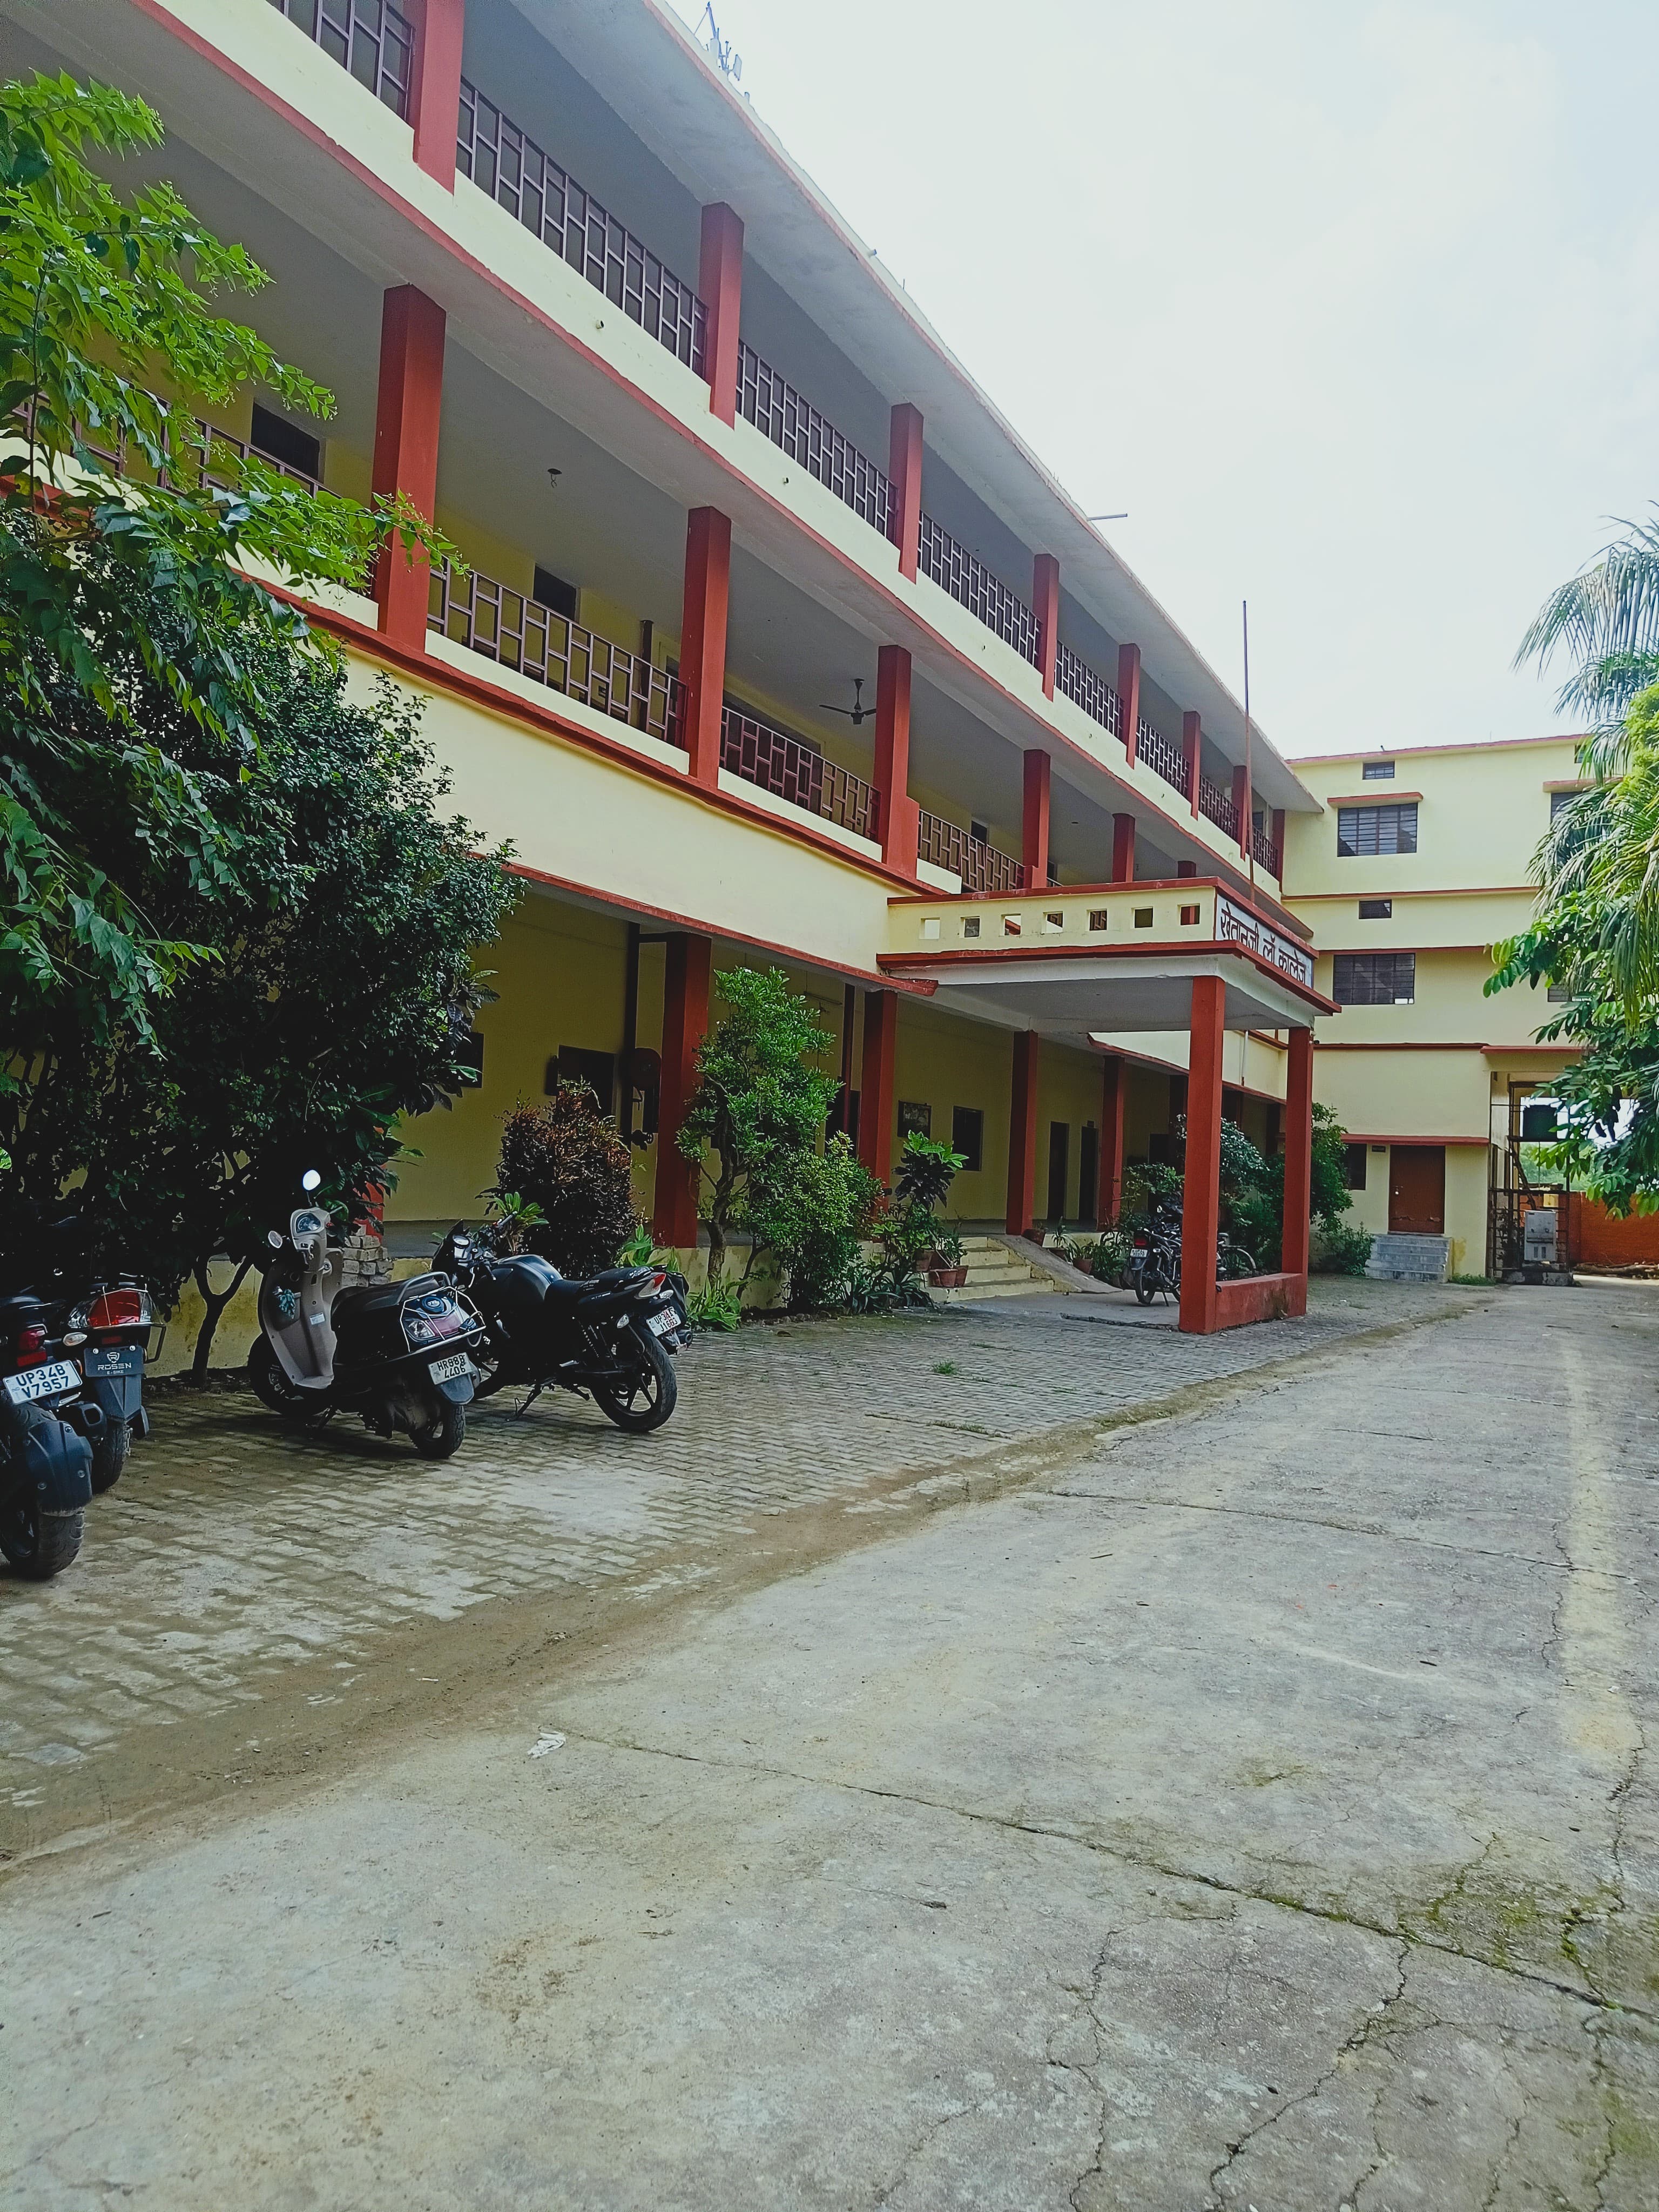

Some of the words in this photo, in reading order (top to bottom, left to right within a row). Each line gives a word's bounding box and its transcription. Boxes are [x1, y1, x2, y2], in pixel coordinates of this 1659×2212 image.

[16, 1364, 66, 1386] UP34B
[97, 1362, 132, 1371] ROSEN
[444, 1363, 466, 1379] 4406
[21, 1375, 69, 1398] V7957
